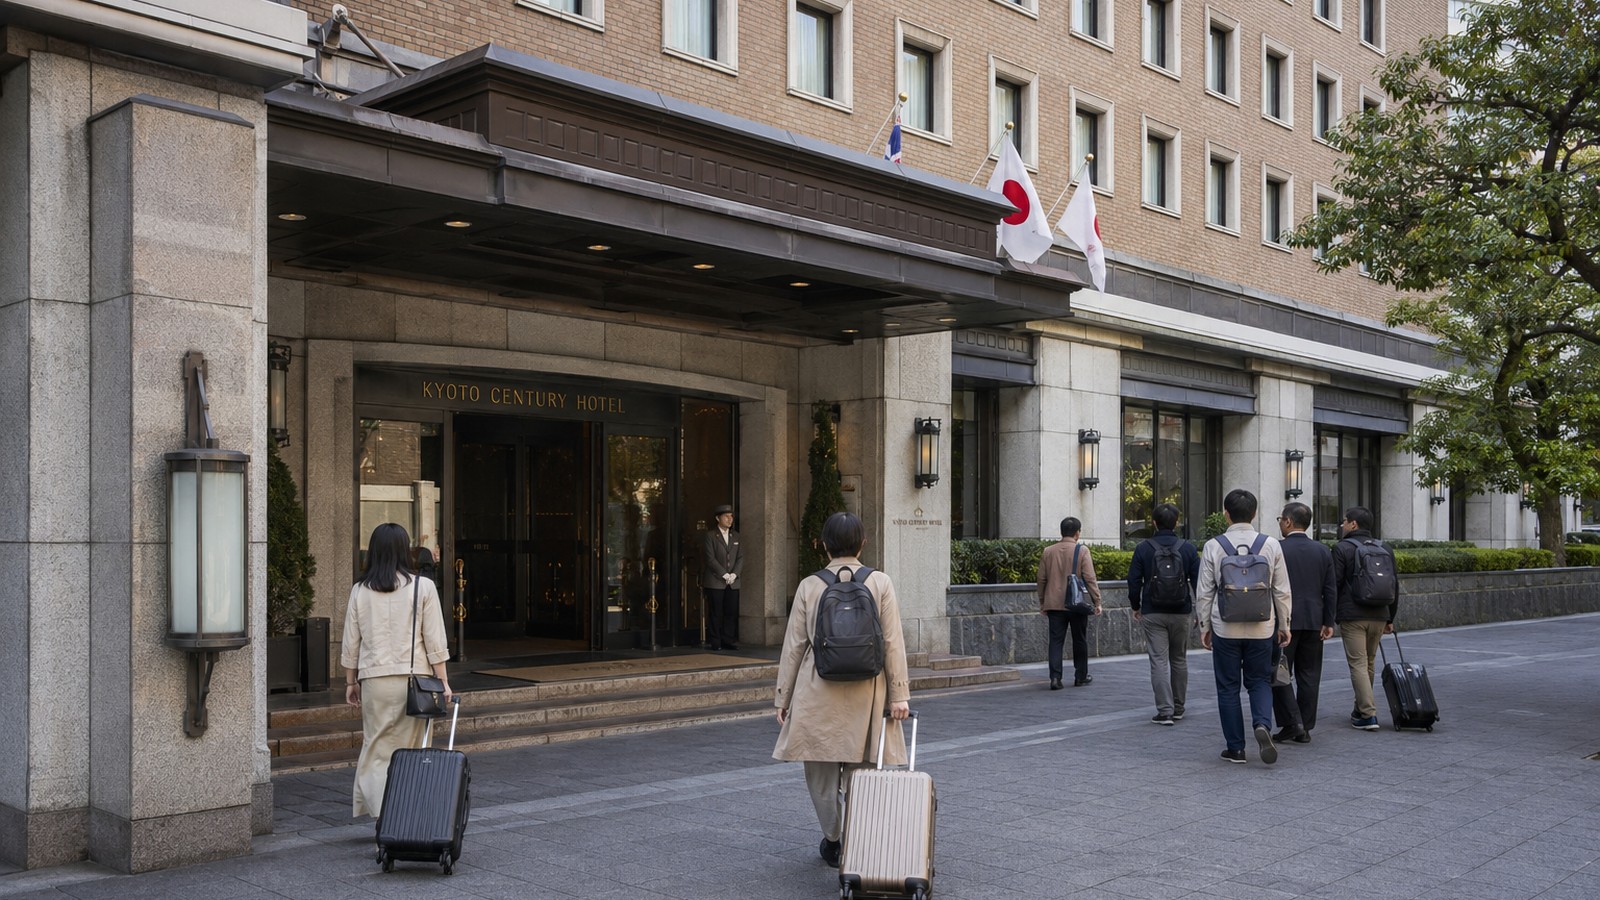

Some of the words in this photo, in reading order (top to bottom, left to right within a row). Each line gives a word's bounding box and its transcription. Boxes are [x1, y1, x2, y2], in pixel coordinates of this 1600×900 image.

[423, 381, 480, 401] KYOTO
[490, 387, 567, 408] CENTURY
[577, 394, 626, 413] HOTEL
